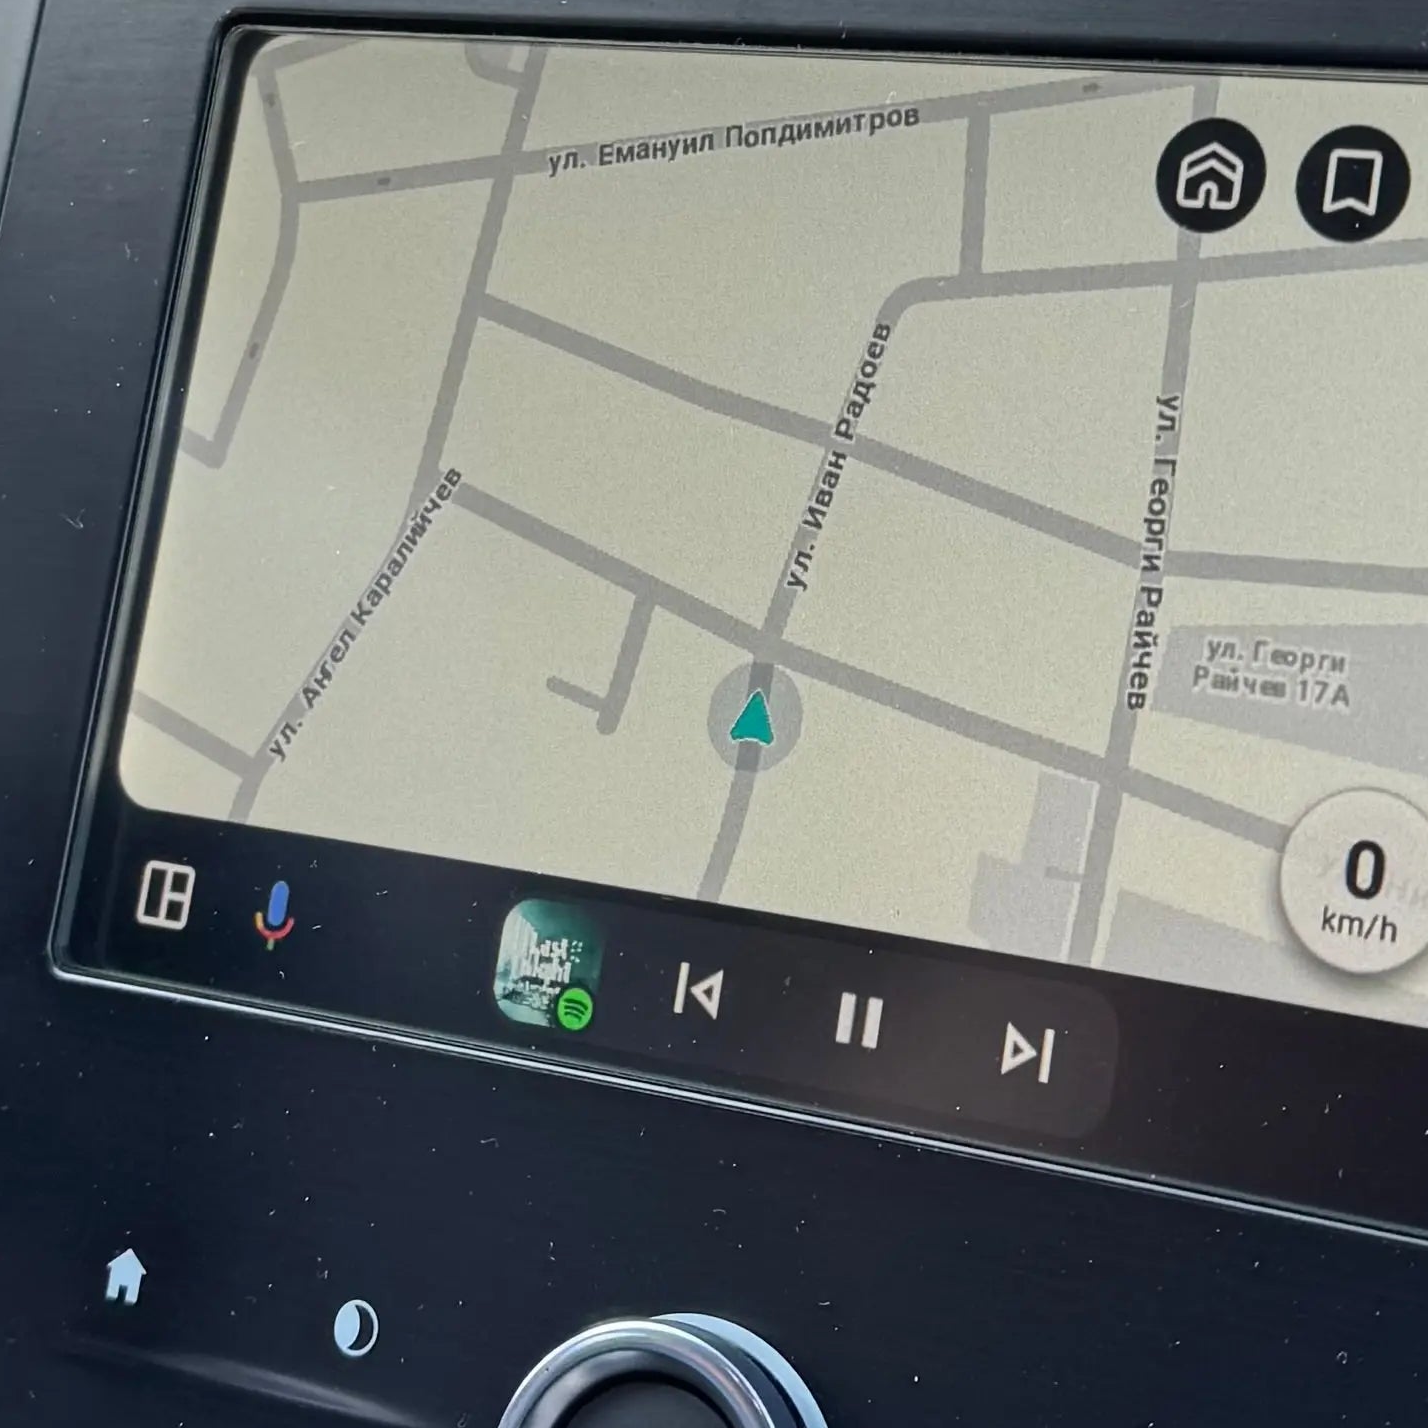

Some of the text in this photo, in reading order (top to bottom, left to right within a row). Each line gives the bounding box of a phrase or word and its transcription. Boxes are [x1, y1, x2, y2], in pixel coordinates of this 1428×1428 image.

[549, 104, 920, 177] ул. Емануил Попдимитров
[786, 322, 891, 591] ул. Иван Радоев
[1127, 396, 1180, 710] ул. Георги Райчев
[269, 467, 462, 762] ул. Ангел Каралийчев
[1192, 664, 1287, 698] Райчев
[1207, 640, 1346, 674] ул. Георги
[1345, 840, 1385, 899] 0
[1321, 905, 1398, 943] km/h
